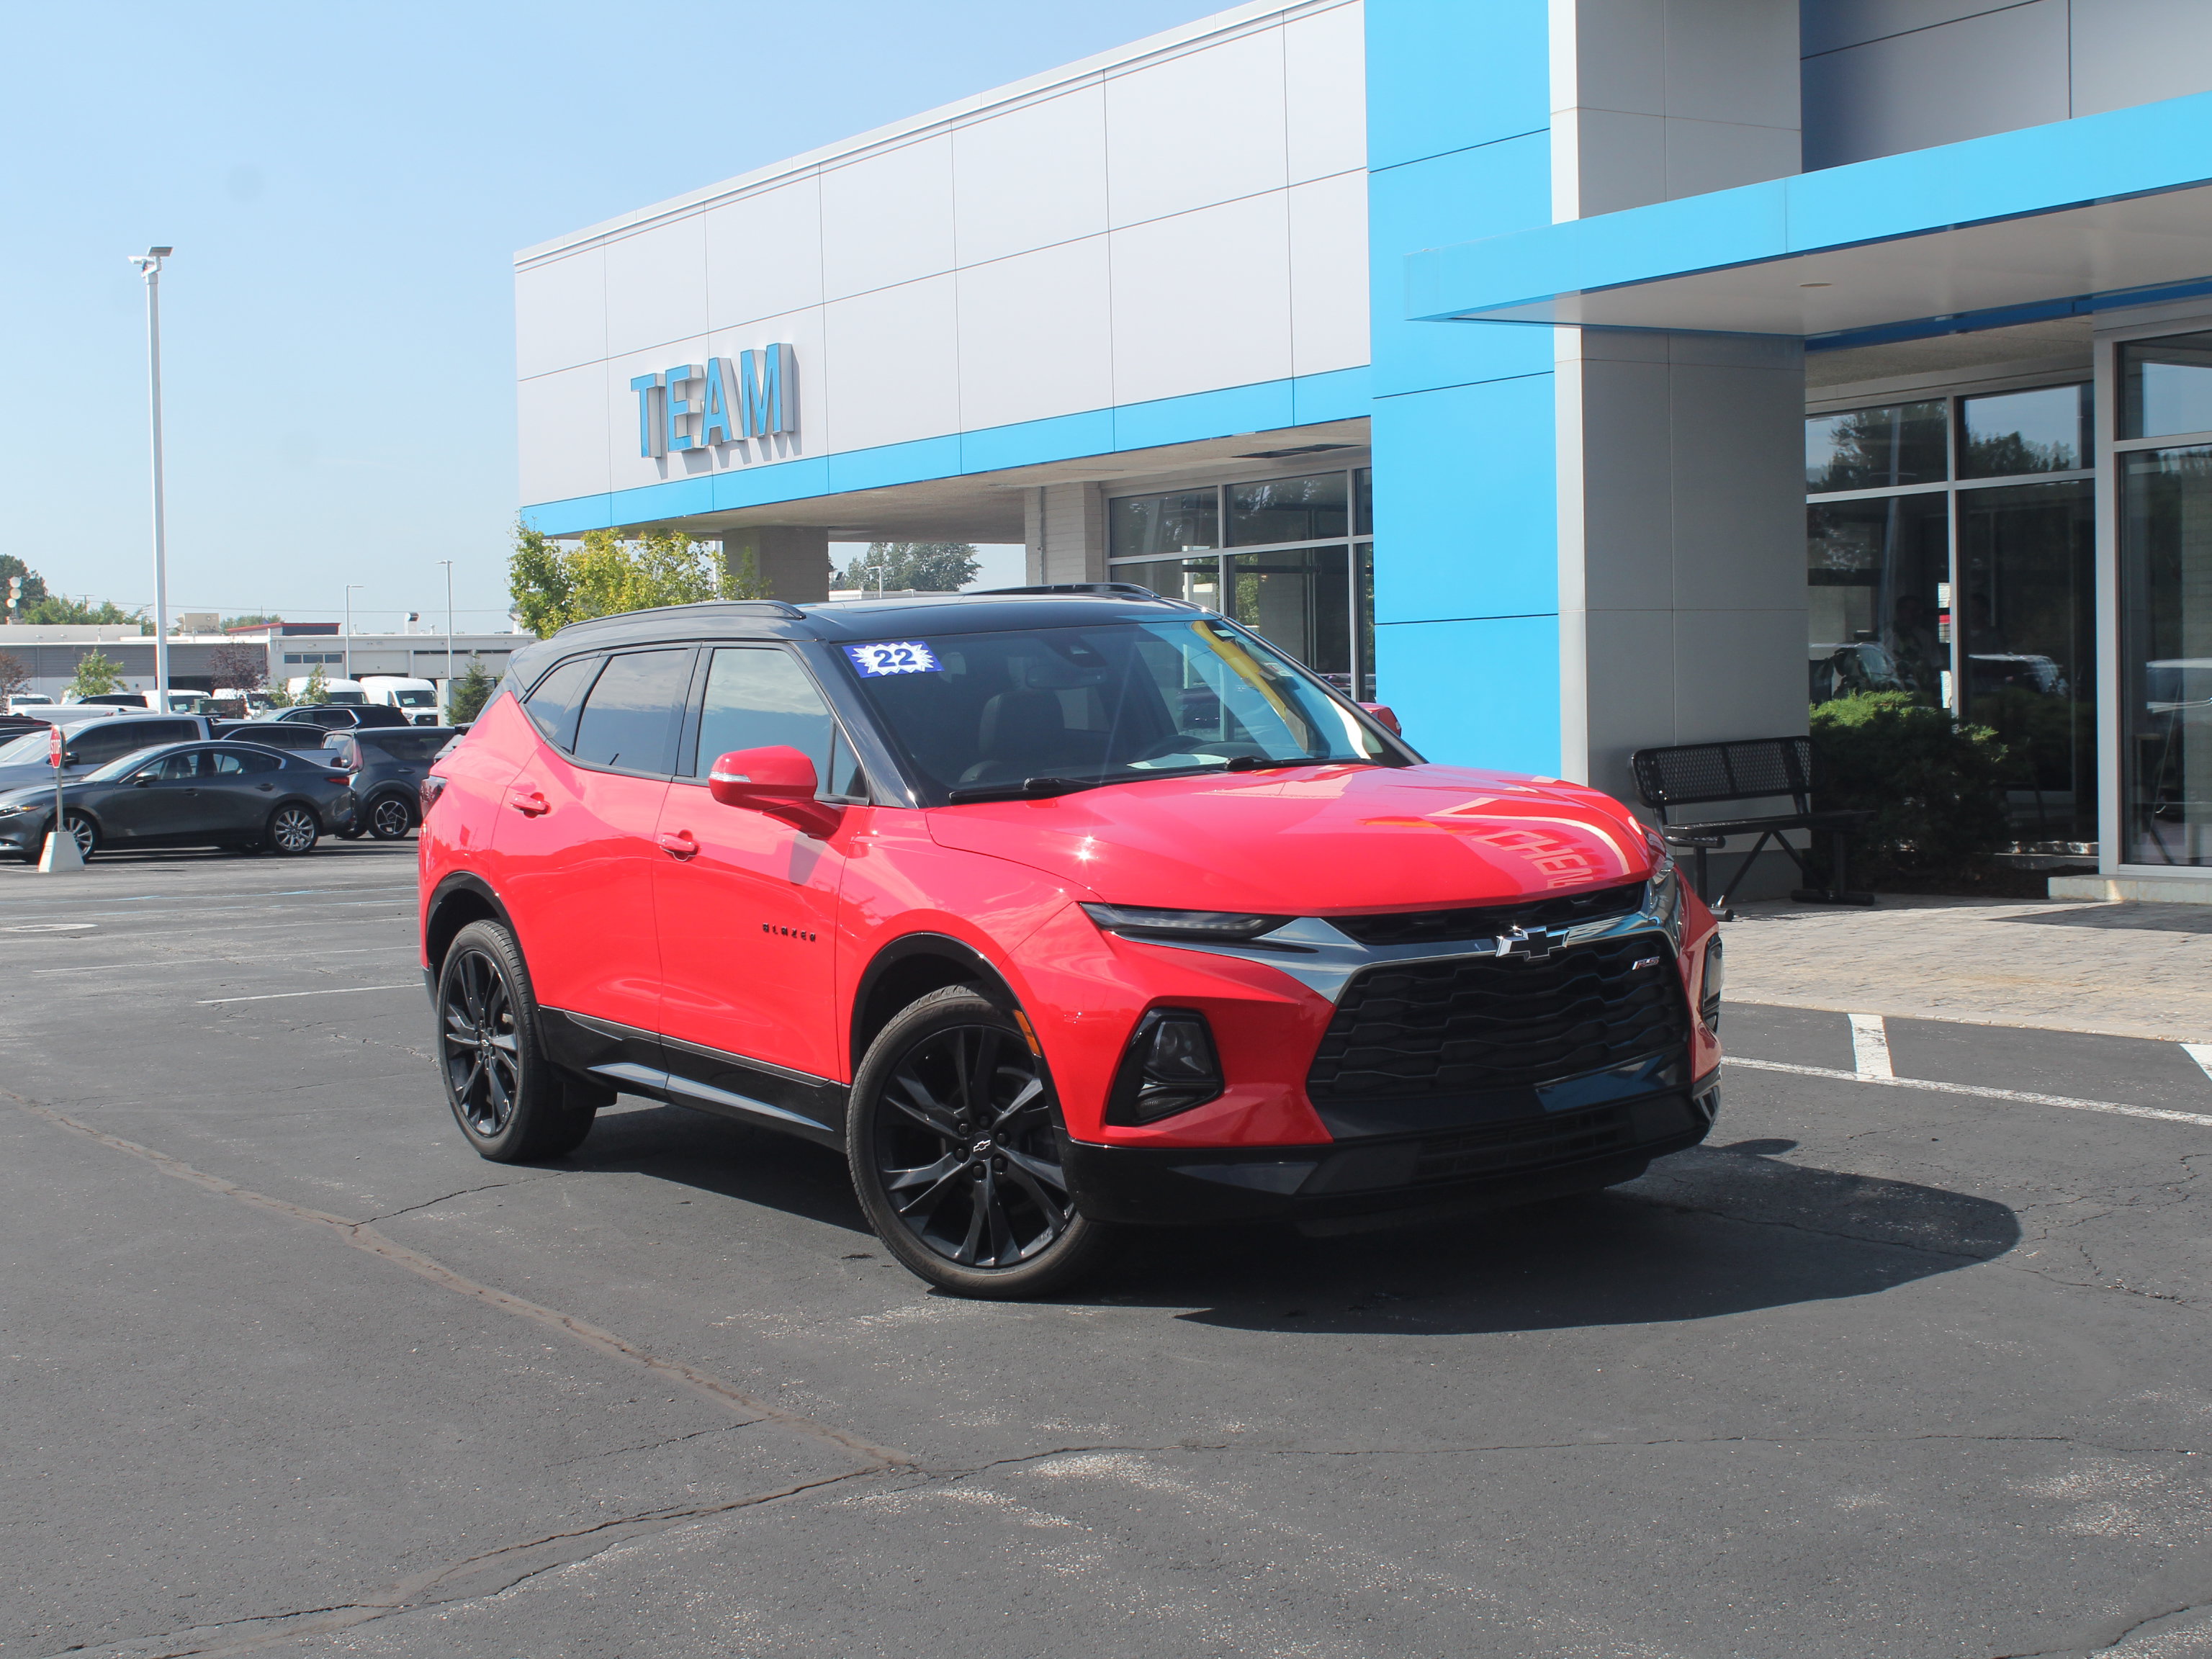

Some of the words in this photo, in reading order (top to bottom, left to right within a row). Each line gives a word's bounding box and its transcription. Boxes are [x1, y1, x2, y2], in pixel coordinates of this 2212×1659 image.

[631, 342, 793, 458] TEAM
[873, 648, 918, 667] 22
[50, 739, 62, 755] STOP
[763, 922, 816, 943] BLAZER
[1632, 956, 1660, 971] RS
